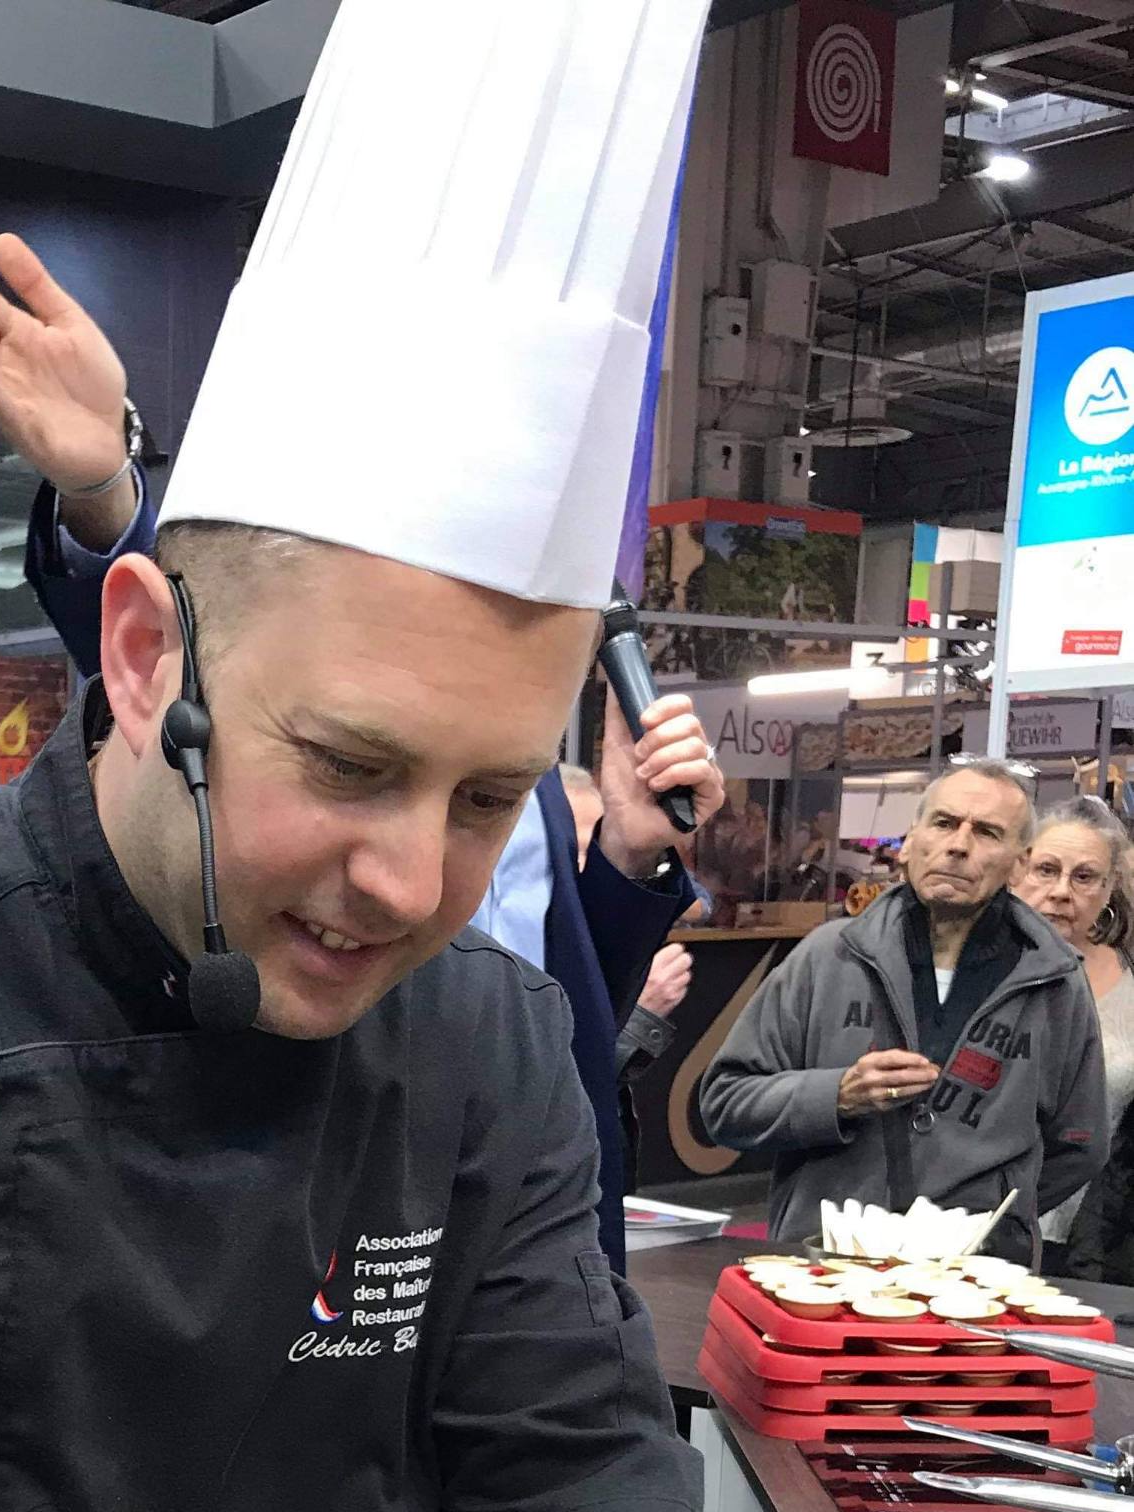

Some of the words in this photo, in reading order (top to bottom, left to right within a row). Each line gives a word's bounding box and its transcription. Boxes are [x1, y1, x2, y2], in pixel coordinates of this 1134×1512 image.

[356, 1227, 443, 1252] Association
[354, 1254, 432, 1278] Française
[353, 1284, 387, 1302] des
[288, 1331, 382, 1363] Cédric
